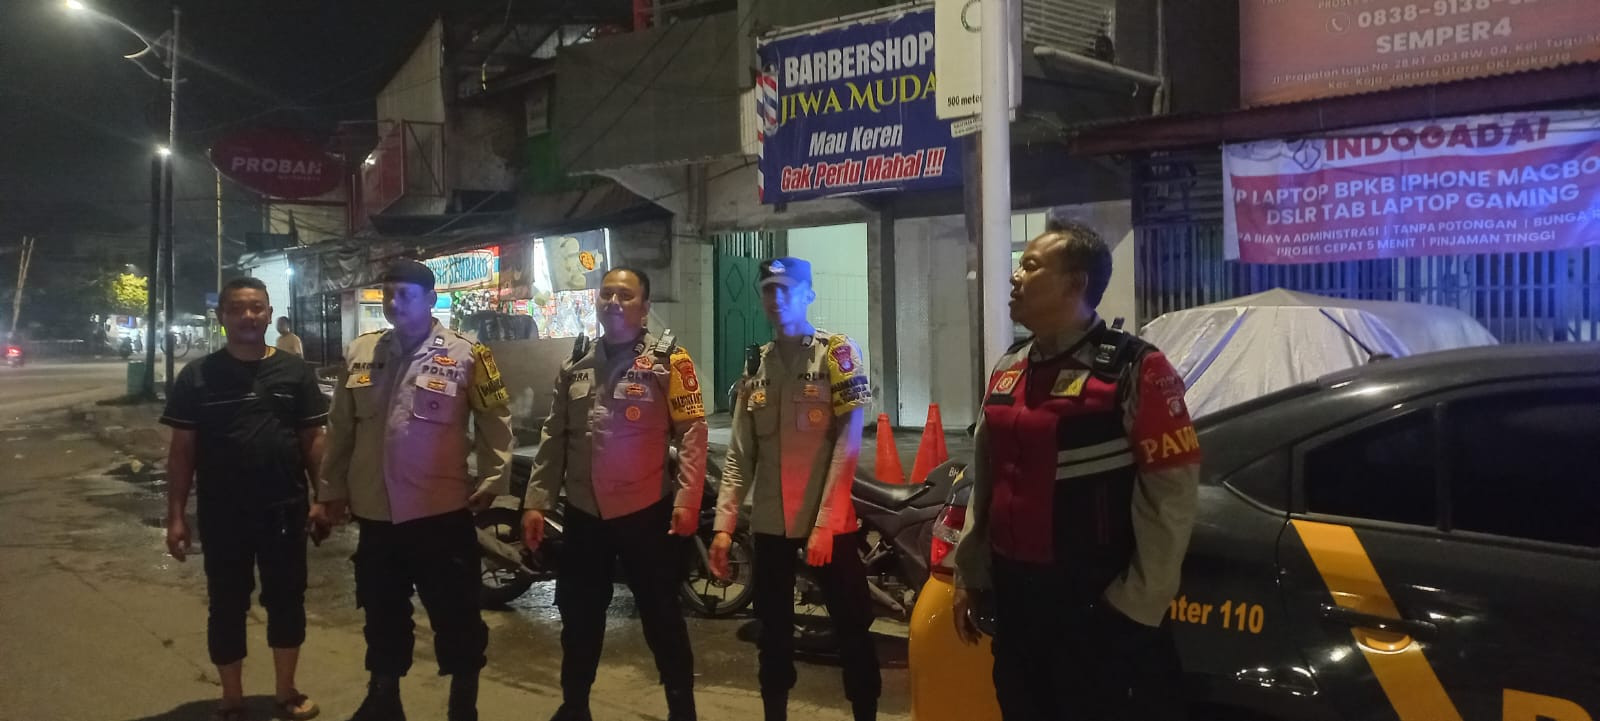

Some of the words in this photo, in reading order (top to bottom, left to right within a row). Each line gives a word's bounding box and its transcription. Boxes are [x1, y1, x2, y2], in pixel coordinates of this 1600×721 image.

[785, 31, 933, 88] BARBERSHOP
[1515, 53, 1570, 66] Jakarta
[780, 90, 842, 127] JIWA
[847, 72, 935, 112] MUDA
[947, 95, 960, 107] 500
[809, 131, 847, 157] Mau
[850, 124, 903, 151] Keren
[781, 164, 811, 192] Gak
[814, 159, 862, 188] Perlu
[863, 149, 922, 183] Mahal
[1253, 184, 1328, 205] LAPTOP
[1335, 176, 1395, 198] BPKB
[1401, 170, 1491, 192] IPHONE
[1267, 206, 1316, 225] DSLR
[1321, 201, 1365, 220] TAB
[1371, 193, 1459, 215] LAPTOP
[1465, 184, 1579, 209] GAMING
[1255, 233, 1291, 244] BIAYA
[1293, 227, 1378, 242] ADMINISTRASI
[1393, 222, 1435, 234] TANPA
[1438, 219, 1517, 231] POTONGAN
[1533, 211, 1586, 227] BUNGA
[1277, 244, 1321, 257] PROSES
[1323, 240, 1363, 253] CEPAT
[1367, 240, 1375, 250] 5
[1377, 237, 1416, 249] MENIT
[1429, 233, 1500, 246] PINJAMAN
[1504, 231, 1555, 243] TINGGI
[1221, 600, 1264, 634] 110
